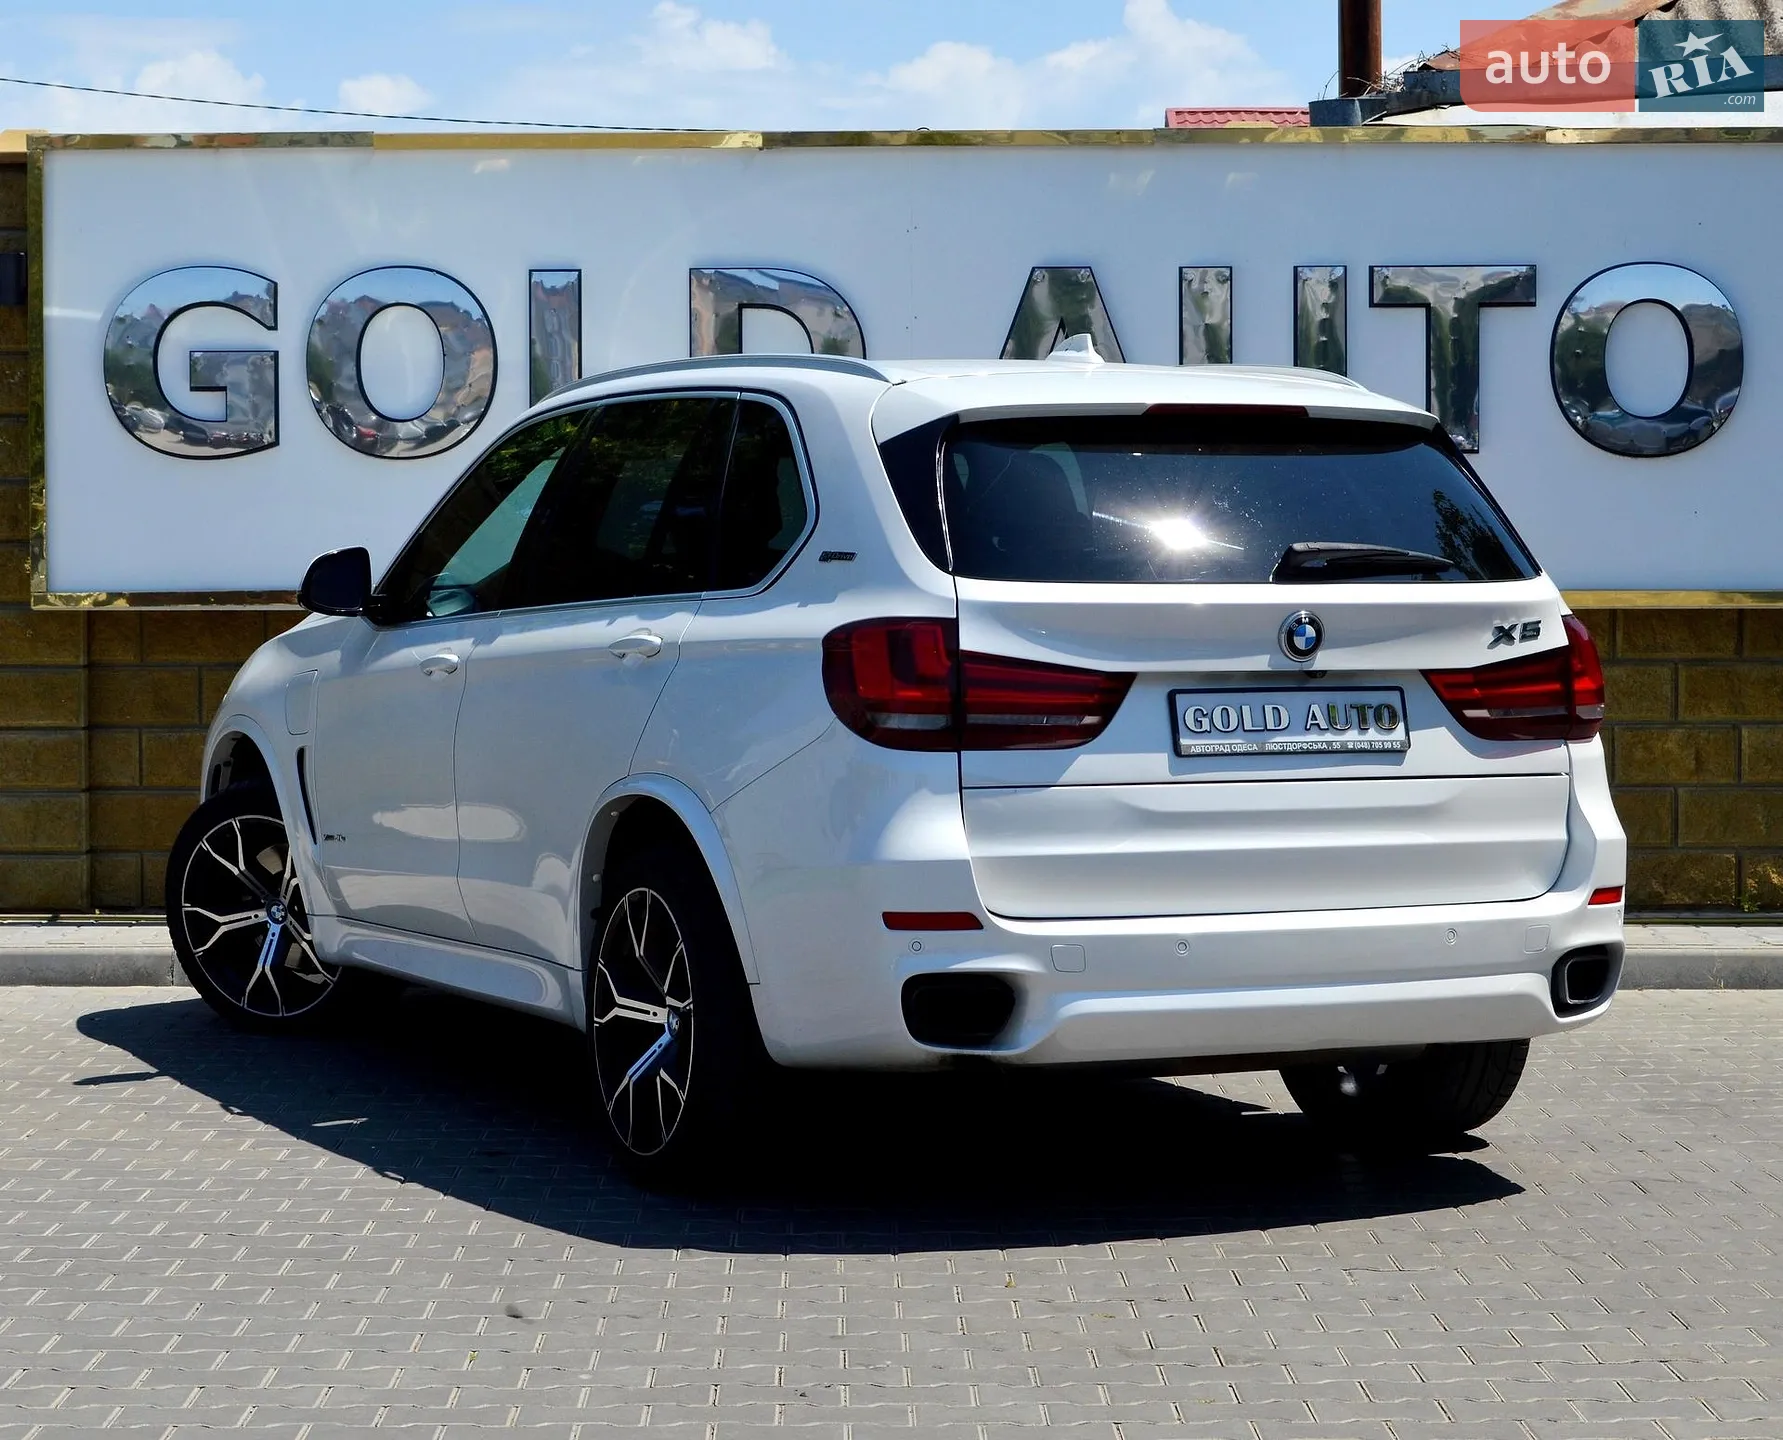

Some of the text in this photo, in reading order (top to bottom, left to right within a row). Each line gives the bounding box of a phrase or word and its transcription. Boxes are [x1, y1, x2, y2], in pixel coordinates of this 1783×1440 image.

[1487, 620, 1541, 650] X5
[1183, 703, 1401, 734] GOLD AUTO
[1190, 744, 1231, 753] АВТОГРАД
[1231, 743, 1259, 752] ОДЕСА
